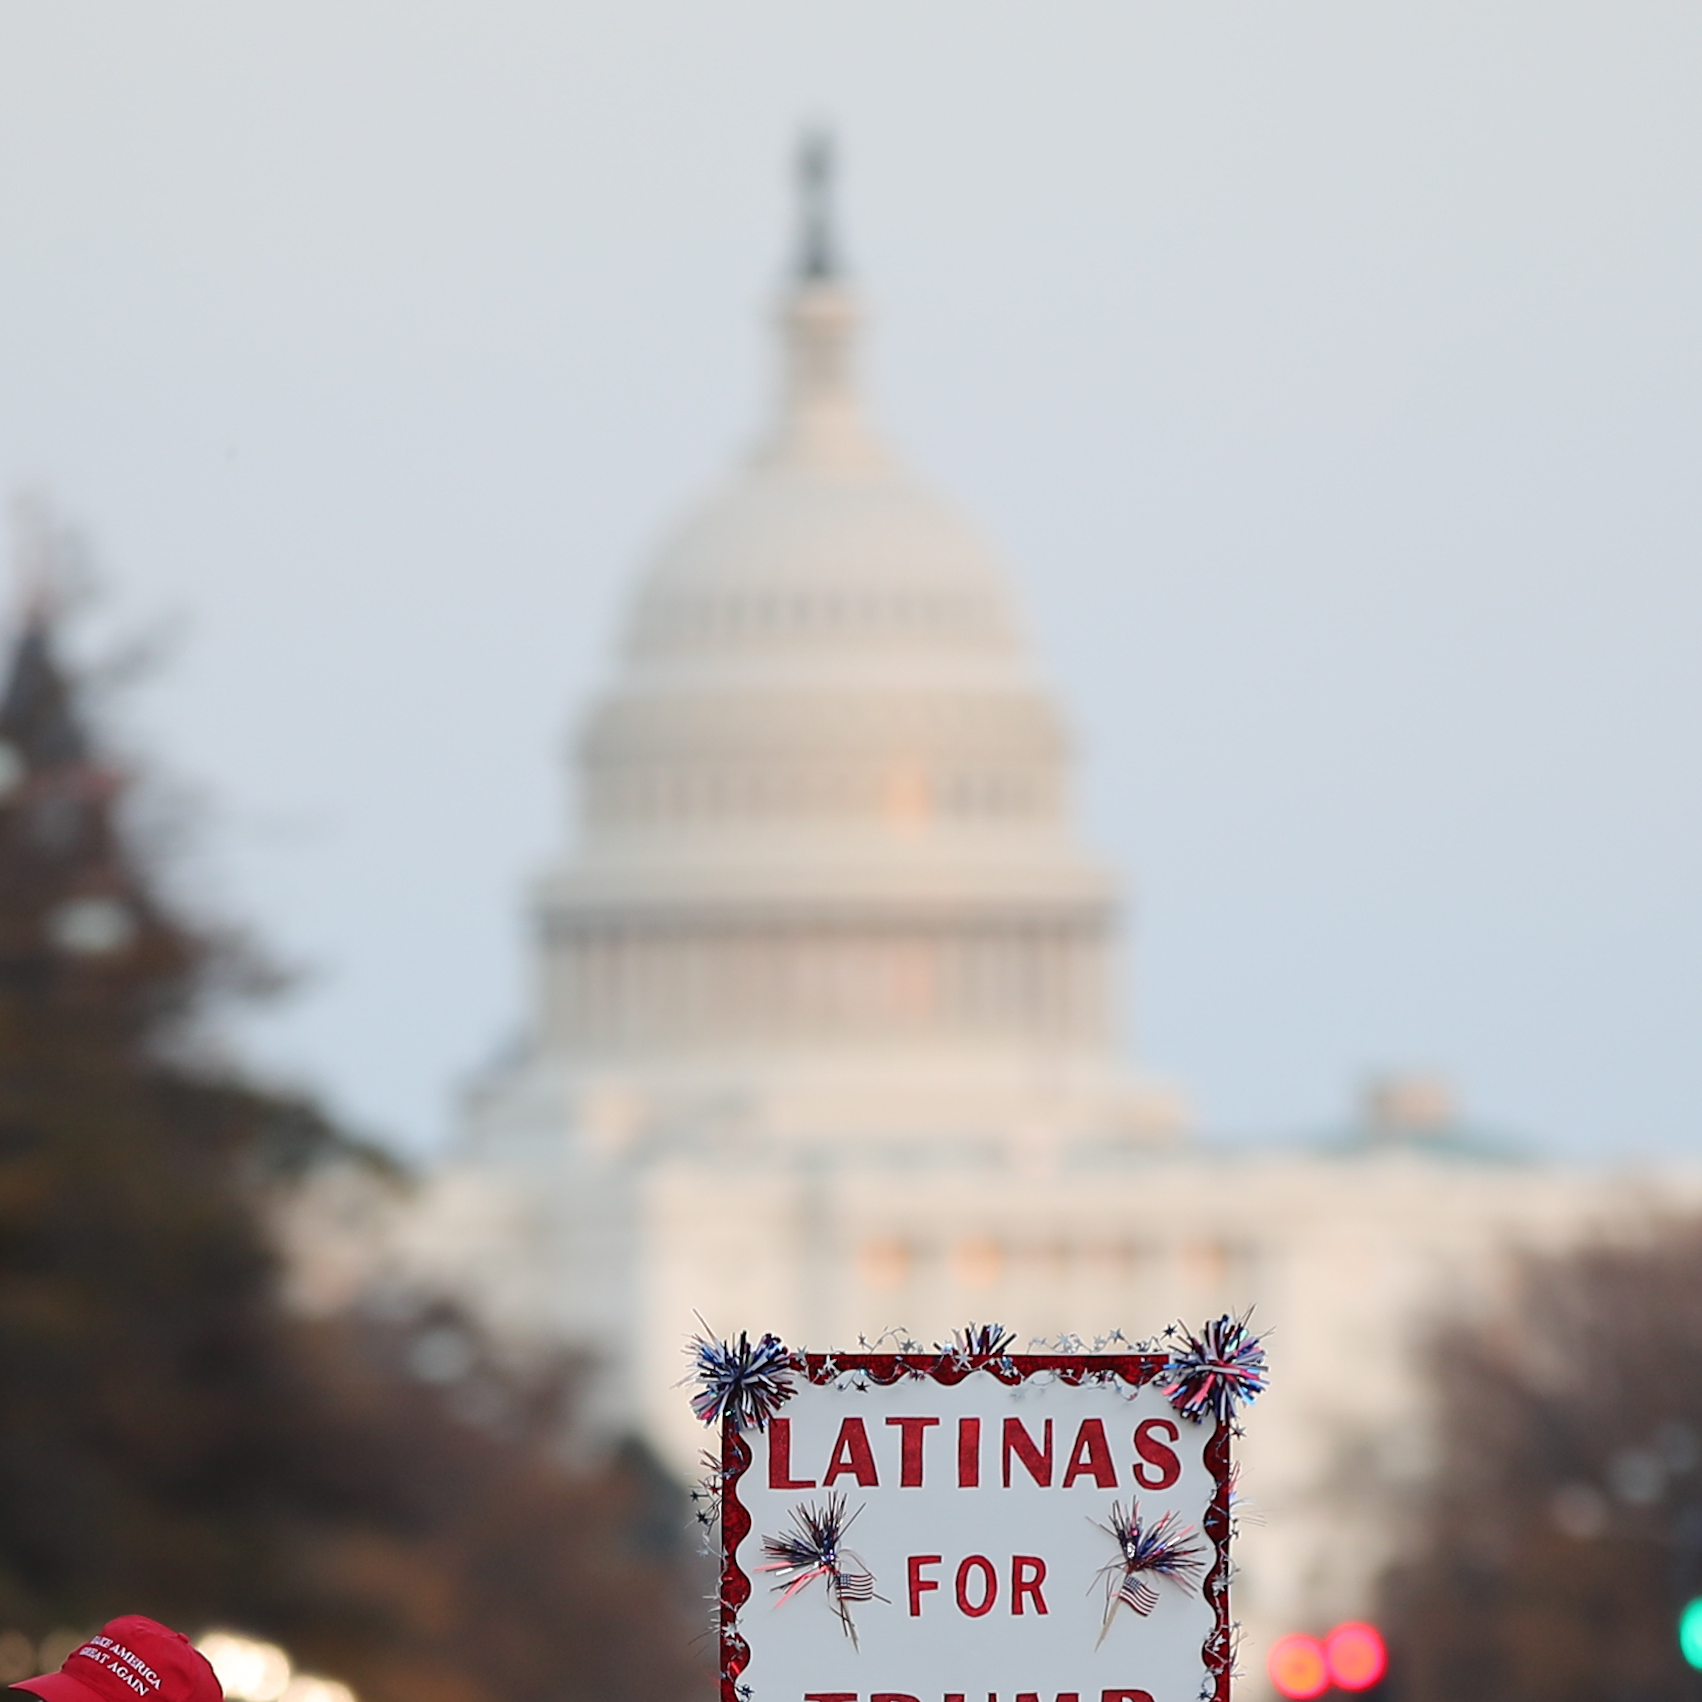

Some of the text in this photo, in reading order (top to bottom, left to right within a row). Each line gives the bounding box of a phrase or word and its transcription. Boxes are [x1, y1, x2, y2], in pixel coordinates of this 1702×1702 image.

[767, 1416, 1181, 1491] LATINAS
[906, 1554, 1049, 1618] FOR
[107, 1661, 150, 1696] AGAIN
[109, 1644, 161, 1690] AMERICA
